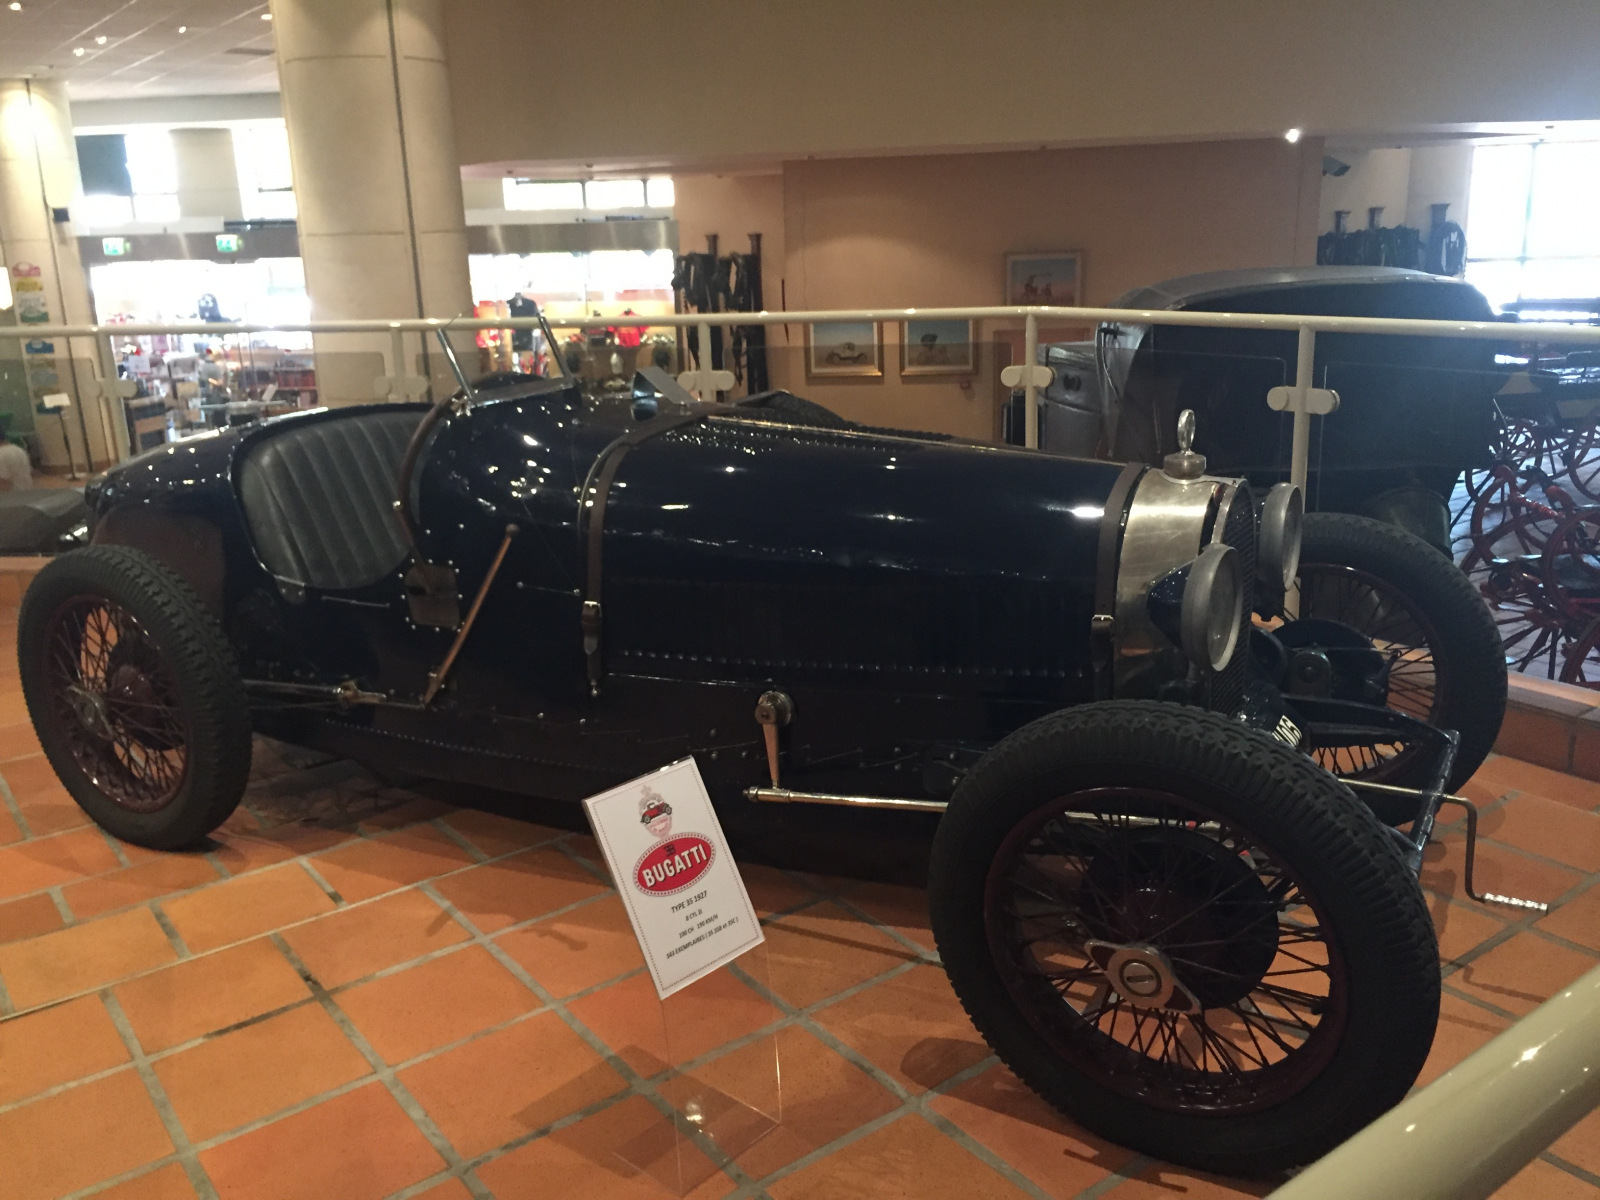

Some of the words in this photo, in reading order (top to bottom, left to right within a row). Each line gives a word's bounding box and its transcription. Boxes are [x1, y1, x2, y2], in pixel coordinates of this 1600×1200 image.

[642, 844, 708, 888] BUGATTI
[671, 901, 686, 913] TYPE
[686, 897, 694, 905] 35
[694, 890, 707, 902] 1927
[705, 914, 718, 924] KM/H
[675, 934, 705, 954] EXEMPLAIRES
